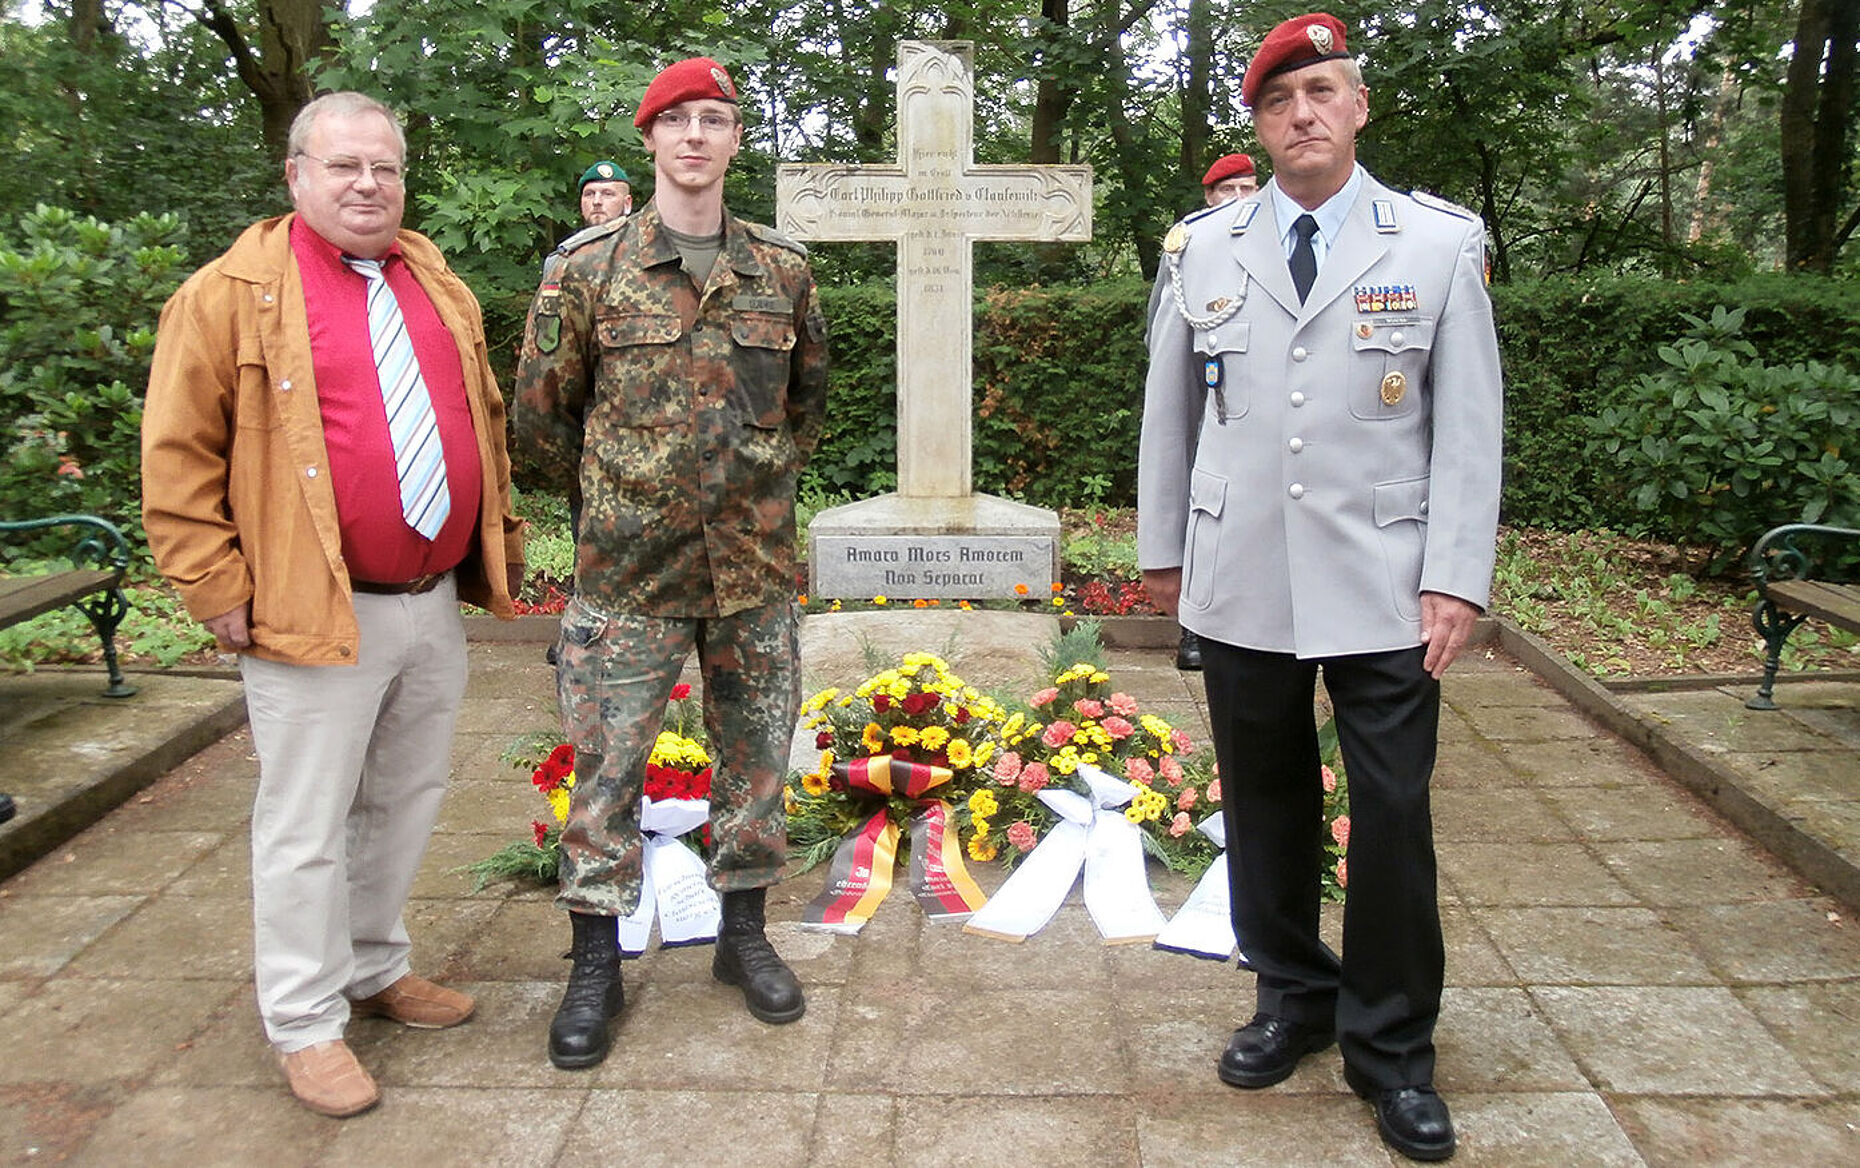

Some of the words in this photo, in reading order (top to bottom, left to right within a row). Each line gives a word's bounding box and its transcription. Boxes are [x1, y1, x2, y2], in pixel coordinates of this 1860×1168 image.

[829, 186, 858, 201] Carl
[860, 186, 903, 204] Philipp
[845, 546, 899, 563] Amara
[907, 546, 951, 563] Mors
[959, 546, 1024, 563] Amorem
[885, 570, 916, 586] Non
[923, 569, 985, 588] Separat
